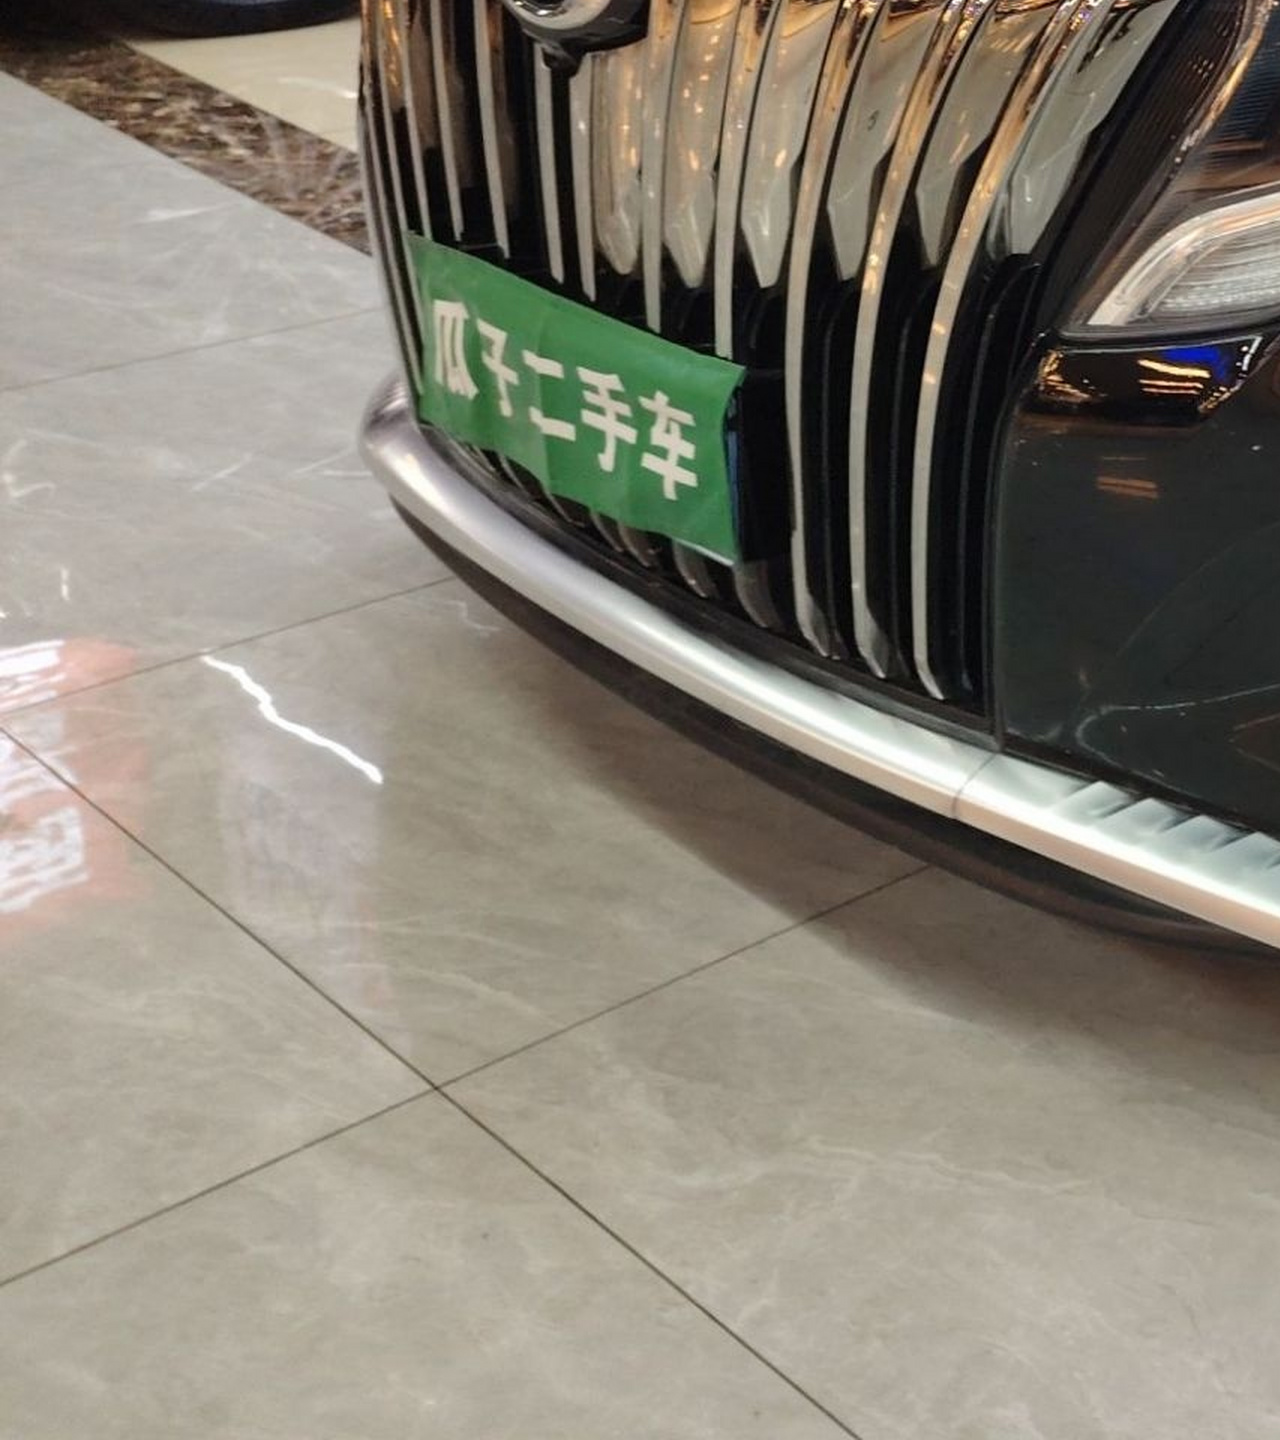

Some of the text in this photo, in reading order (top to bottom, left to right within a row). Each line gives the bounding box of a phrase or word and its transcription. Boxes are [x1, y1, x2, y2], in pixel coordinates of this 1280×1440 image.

[433, 299, 698, 501] 瓜子二手车
